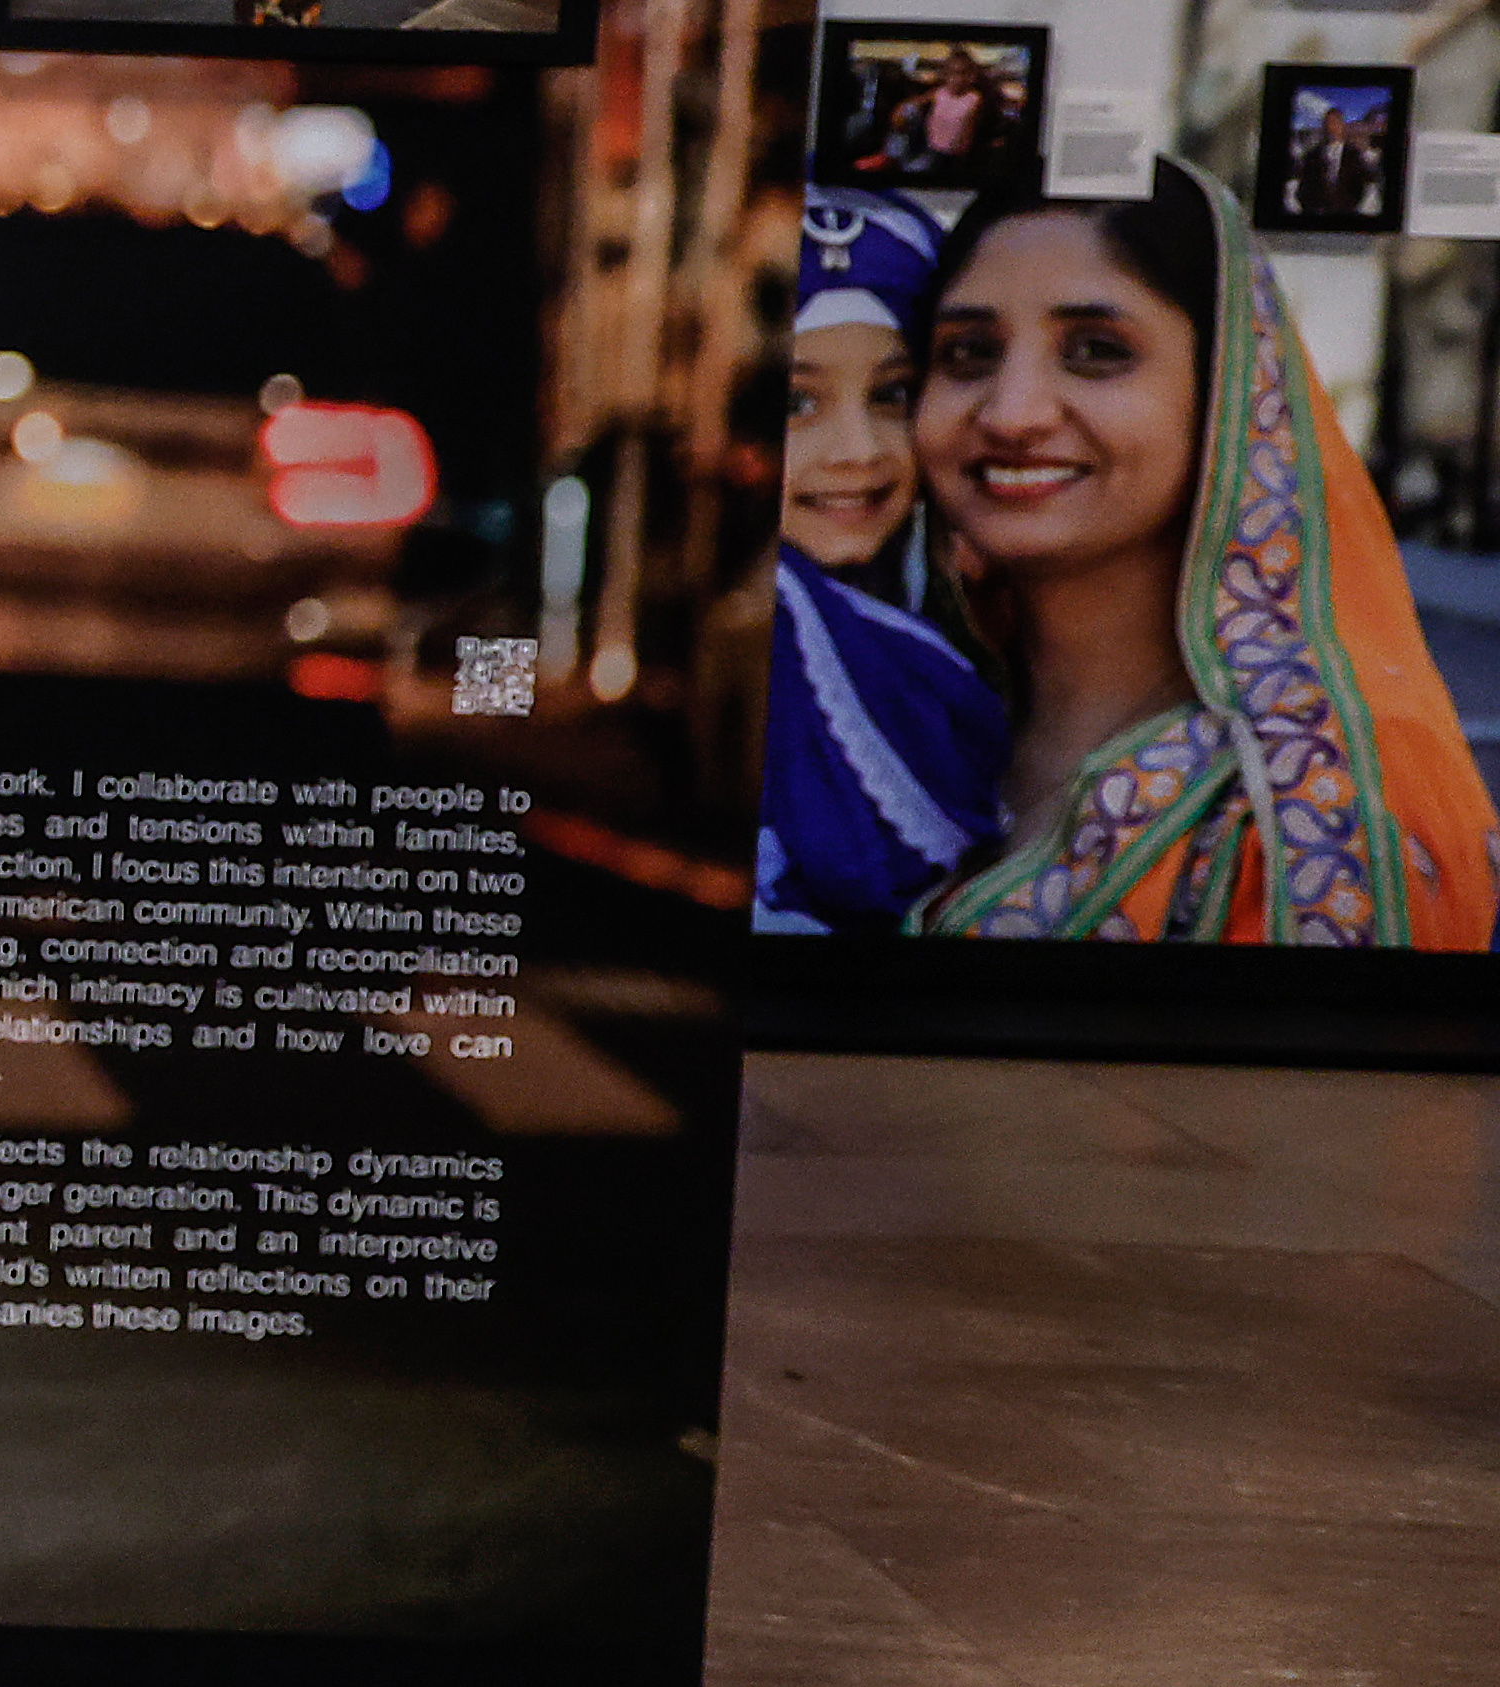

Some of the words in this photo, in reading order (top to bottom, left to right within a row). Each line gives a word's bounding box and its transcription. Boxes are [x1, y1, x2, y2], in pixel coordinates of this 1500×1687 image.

[75, 769, 81, 798] I
[97, 770, 279, 804] collaborate
[292, 776, 357, 807] with
[371, 781, 484, 816] people
[499, 783, 531, 813] to
[45, 809, 108, 839] and
[129, 811, 262, 844] tensions
[282, 816, 374, 848] within
[396, 820, 525, 856] families,
[95, 851, 100, 880] I
[112, 852, 199, 884] focus
[209, 855, 264, 886] this
[274, 857, 408, 891] intention
[417, 867, 458, 892] on
[469, 864, 524, 894] two
[134, 897, 312, 934] community.
[325, 900, 422, 932] Within
[433, 903, 521, 935] these
[41, 935, 217, 966] connection
[230, 939, 293, 969] and
[307, 943, 518, 976] reconciliation
[71, 973, 203, 1013] intimacy
[216, 979, 242, 1008] is
[255, 981, 411, 1014] cultivated
[423, 986, 515, 1018] within
[192, 1019, 256, 1049] and
[276, 1021, 344, 1052] how
[364, 1024, 431, 1055] love
[450, 1032, 512, 1058] can
[82, 1136, 133, 1167] the
[149, 1140, 332, 1180] relationship
[348, 1146, 503, 1182] dynamics
[63, 1180, 241, 1212] generation.
[255, 1183, 318, 1214] This
[327, 1186, 464, 1222] dynamic
[473, 1191, 500, 1221] is
[49, 1219, 152, 1252] parent
[174, 1222, 237, 1252] and
[257, 1229, 298, 1254] an
[319, 1226, 497, 1264] interpretive
[64, 1258, 170, 1290] written
[187, 1262, 350, 1296] reflections
[366, 1272, 407, 1298] on
[425, 1270, 495, 1301] their
[92, 1298, 181, 1331] these
[187, 1302, 312, 1339] images.
